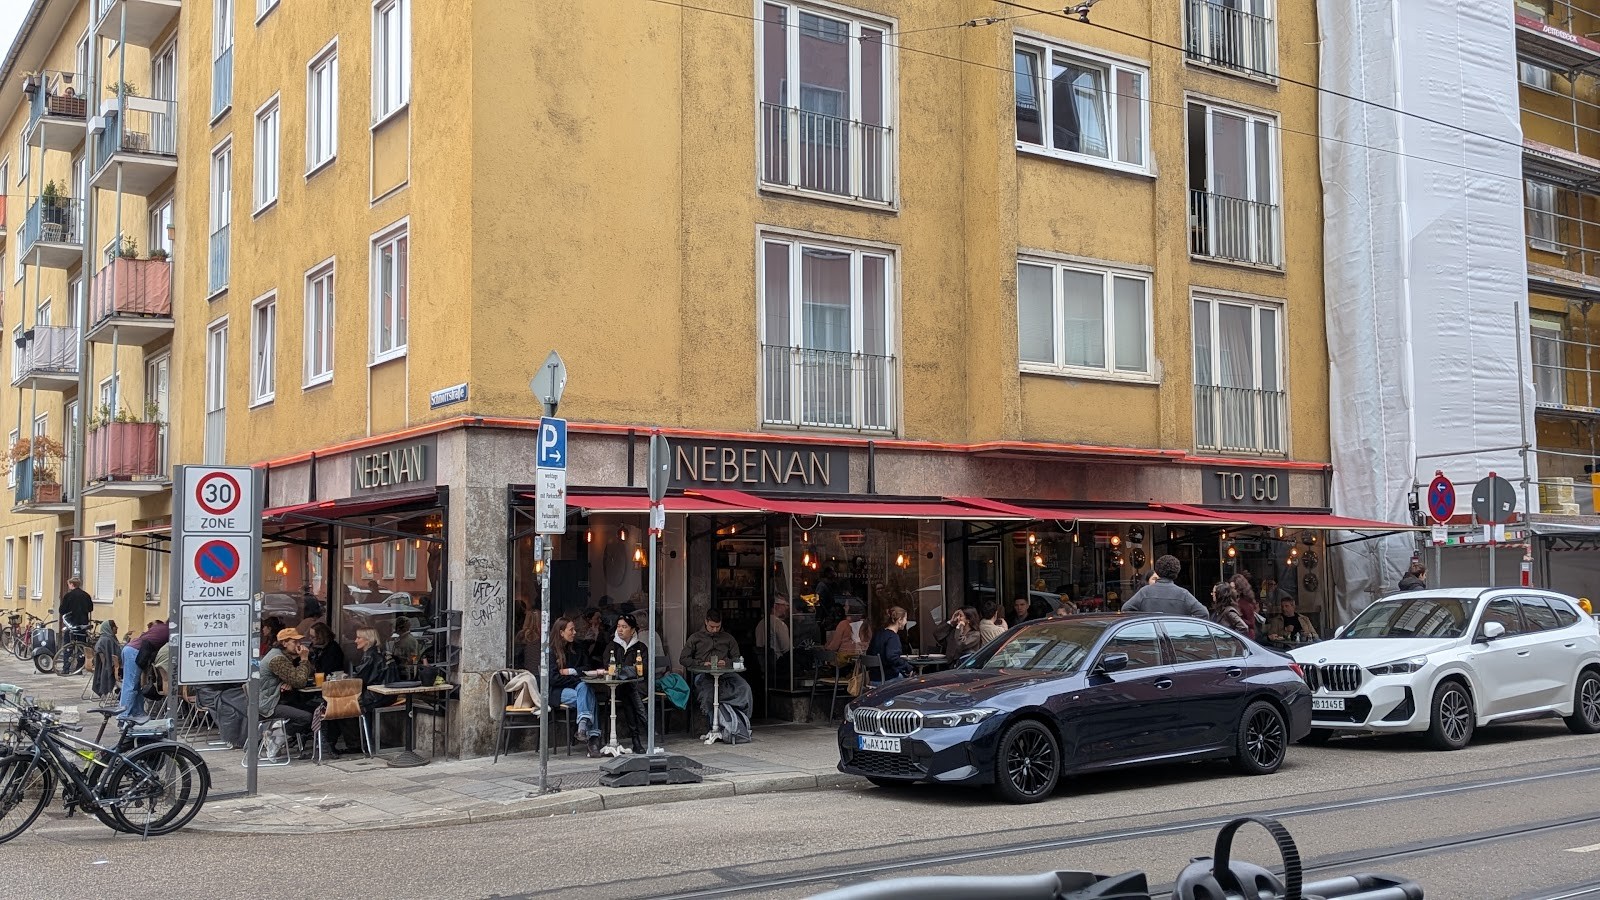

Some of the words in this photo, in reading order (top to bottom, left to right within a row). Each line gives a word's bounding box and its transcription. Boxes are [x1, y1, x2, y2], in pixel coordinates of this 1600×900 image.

[541, 423, 558, 462] P
[355, 444, 423, 490] NEBENAN
[675, 445, 831, 486] NEBENAN
[1216, 471, 1245, 500] TO
[1251, 473, 1279, 501] GO
[205, 483, 232, 504] 30
[201, 517, 235, 529] ZONE
[199, 586, 234, 597] ZONE
[196, 612, 236, 621] werktags
[203, 621, 229, 630] 9-23h
[185, 639, 228, 649] Bewohner
[231, 639, 245, 648] mit
[188, 648, 242, 658] Parkausweis
[195, 659, 235, 668] TU-Viertel
[207, 668, 222, 677] frei
